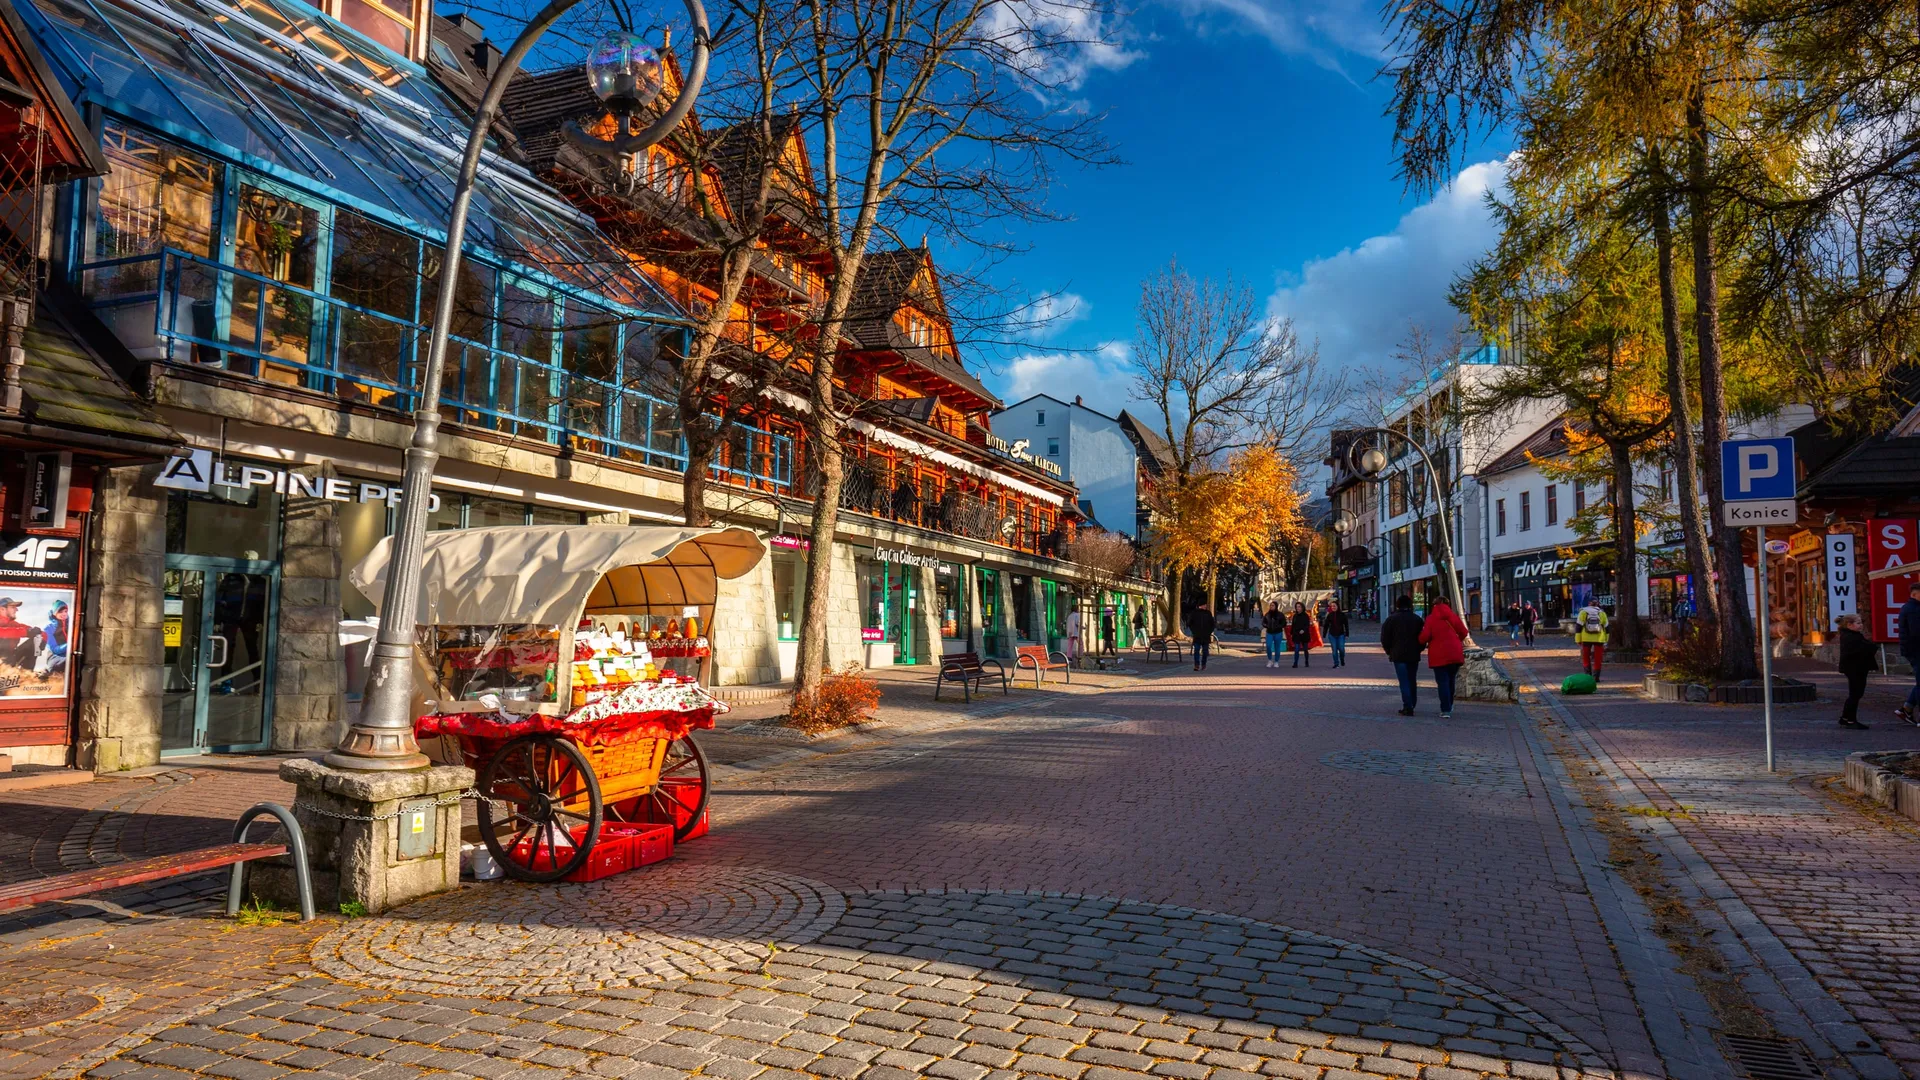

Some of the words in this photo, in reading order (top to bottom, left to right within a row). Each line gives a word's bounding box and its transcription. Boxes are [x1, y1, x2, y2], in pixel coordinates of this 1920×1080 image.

[986, 433, 1009, 453] HOTEL
[157, 453, 351, 502] ALPINE
[1738, 444, 1779, 493] P
[1731, 506, 1789, 520] Koniec
[3, 537, 70, 569] 4F
[32, 570, 69, 579] FIRMOWE
[1833, 541, 1850, 618] OBUWI
